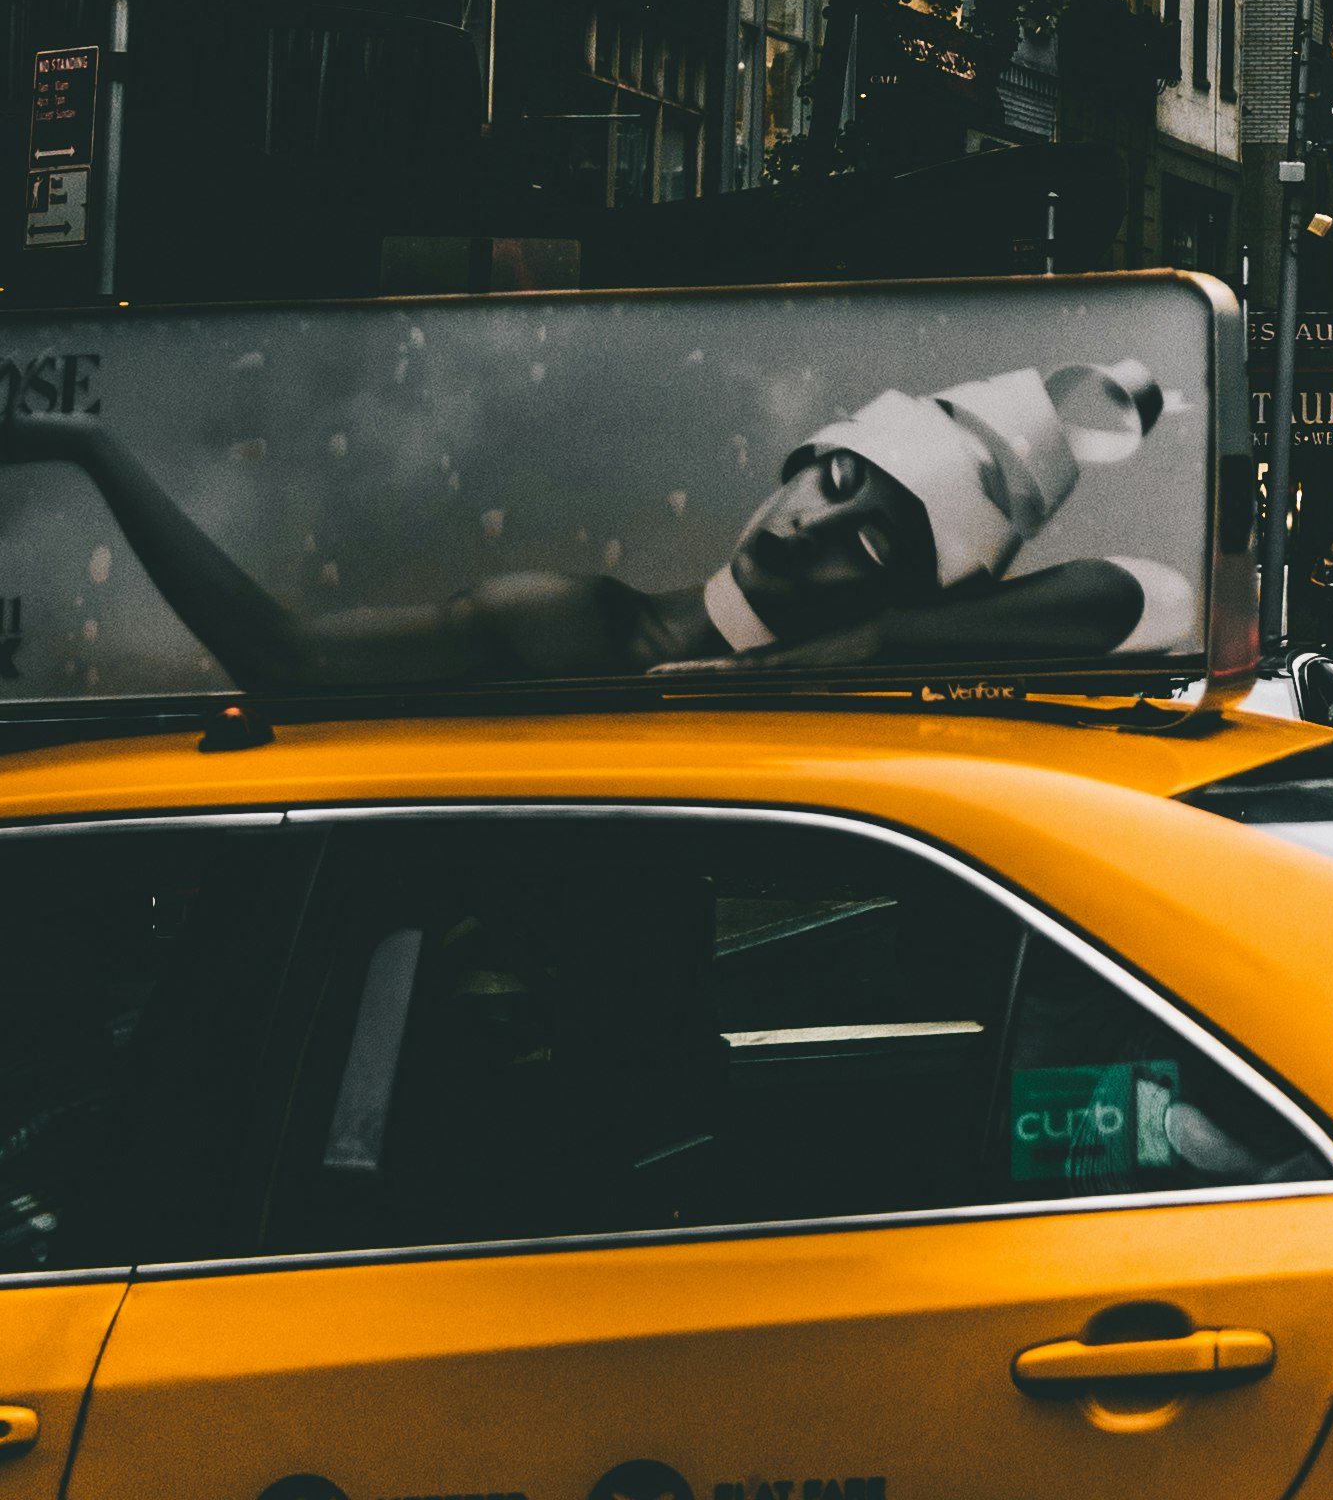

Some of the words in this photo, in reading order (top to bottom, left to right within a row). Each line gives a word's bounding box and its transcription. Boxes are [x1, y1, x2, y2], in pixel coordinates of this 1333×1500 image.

[39, 59, 49, 73] NO
[51, 56, 88, 71] STANDING
[1016, 1101, 1124, 1141] curb
